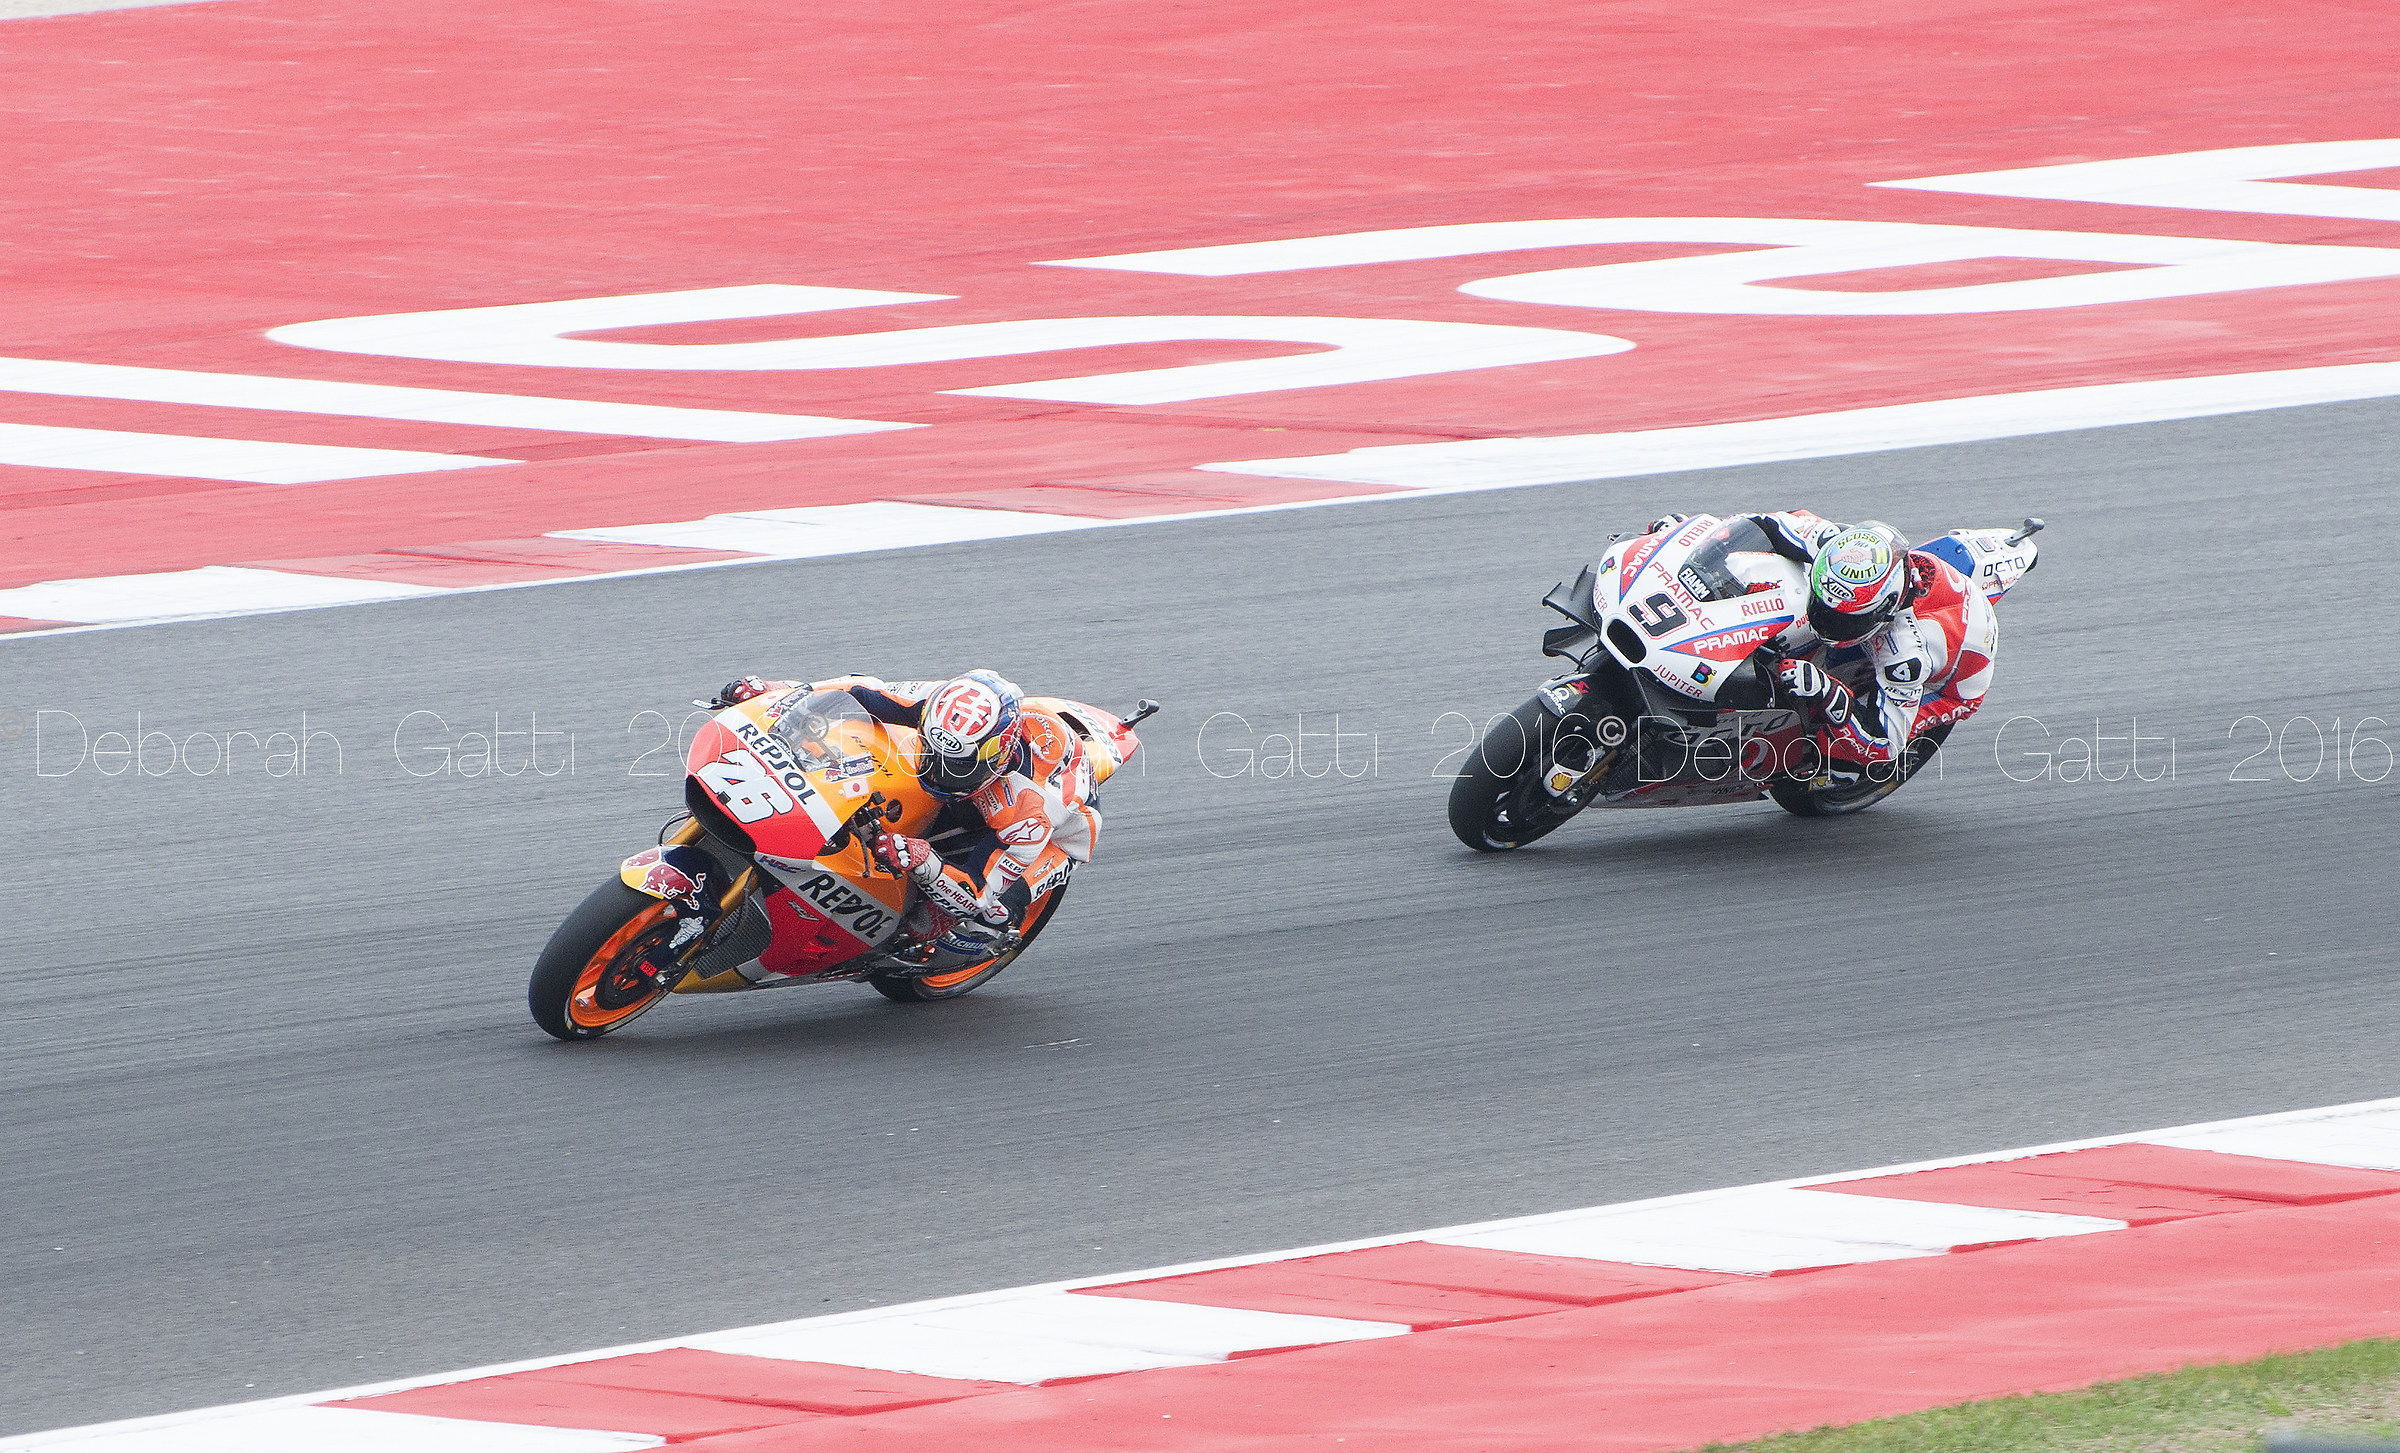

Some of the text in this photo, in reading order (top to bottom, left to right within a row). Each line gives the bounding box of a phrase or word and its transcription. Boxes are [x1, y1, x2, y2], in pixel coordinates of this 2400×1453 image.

[1678, 519, 1715, 547] RIELLO
[1837, 532, 1881, 550] SCOSSI
[1679, 567, 1711, 600] FIAMM
[1840, 564, 1878, 580] UNITI
[1983, 556, 2026, 578] OCTO
[1649, 561, 1715, 631] PRAMAC
[1740, 597, 1785, 617] RIELLO
[1626, 590, 1691, 641] 9
[1693, 626, 1769, 654] PRAMAC
[1653, 664, 1703, 698] JUPITER
[932, 730, 962, 749] Arai
[1065, 702, 1122, 764] REPSO
[736, 723, 817, 806] REPSOL
[697, 749, 795, 825] 26
[798, 872, 895, 941] REPSOL
[935, 879, 952, 895] One
[950, 890, 980, 913] HEART
